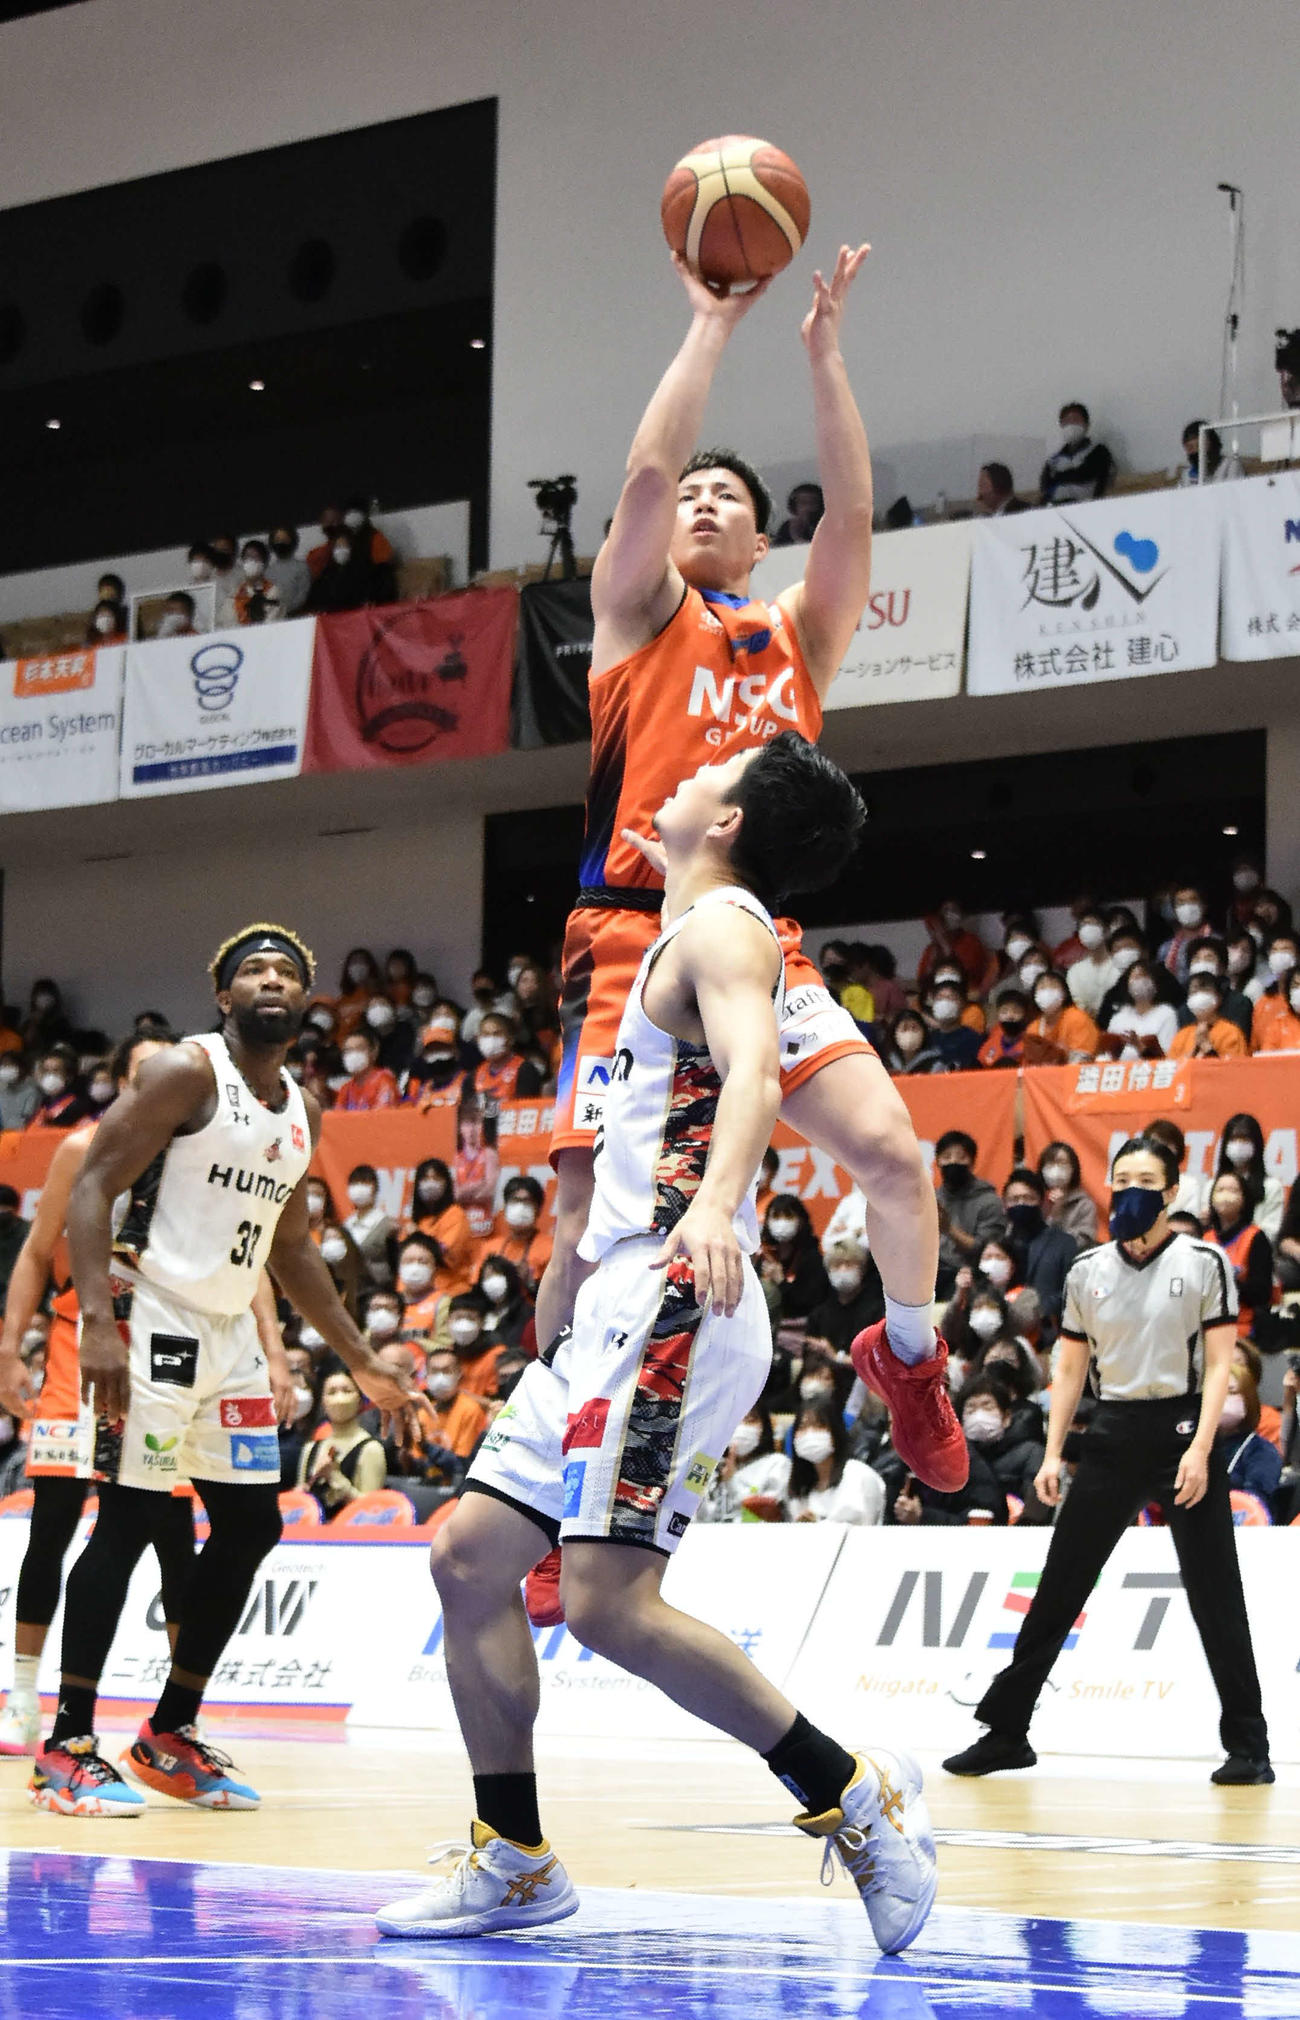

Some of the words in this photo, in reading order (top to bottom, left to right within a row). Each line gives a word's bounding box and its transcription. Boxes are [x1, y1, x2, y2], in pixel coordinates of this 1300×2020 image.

[1013, 639, 1116, 682] 株式会社
[1127, 633, 1180, 668] 建心
[48, 712, 116, 742] System
[854, 1673, 939, 1698] Niigata
[1068, 1679, 1136, 1700] Smile
[1141, 1680, 1176, 1700] TV
